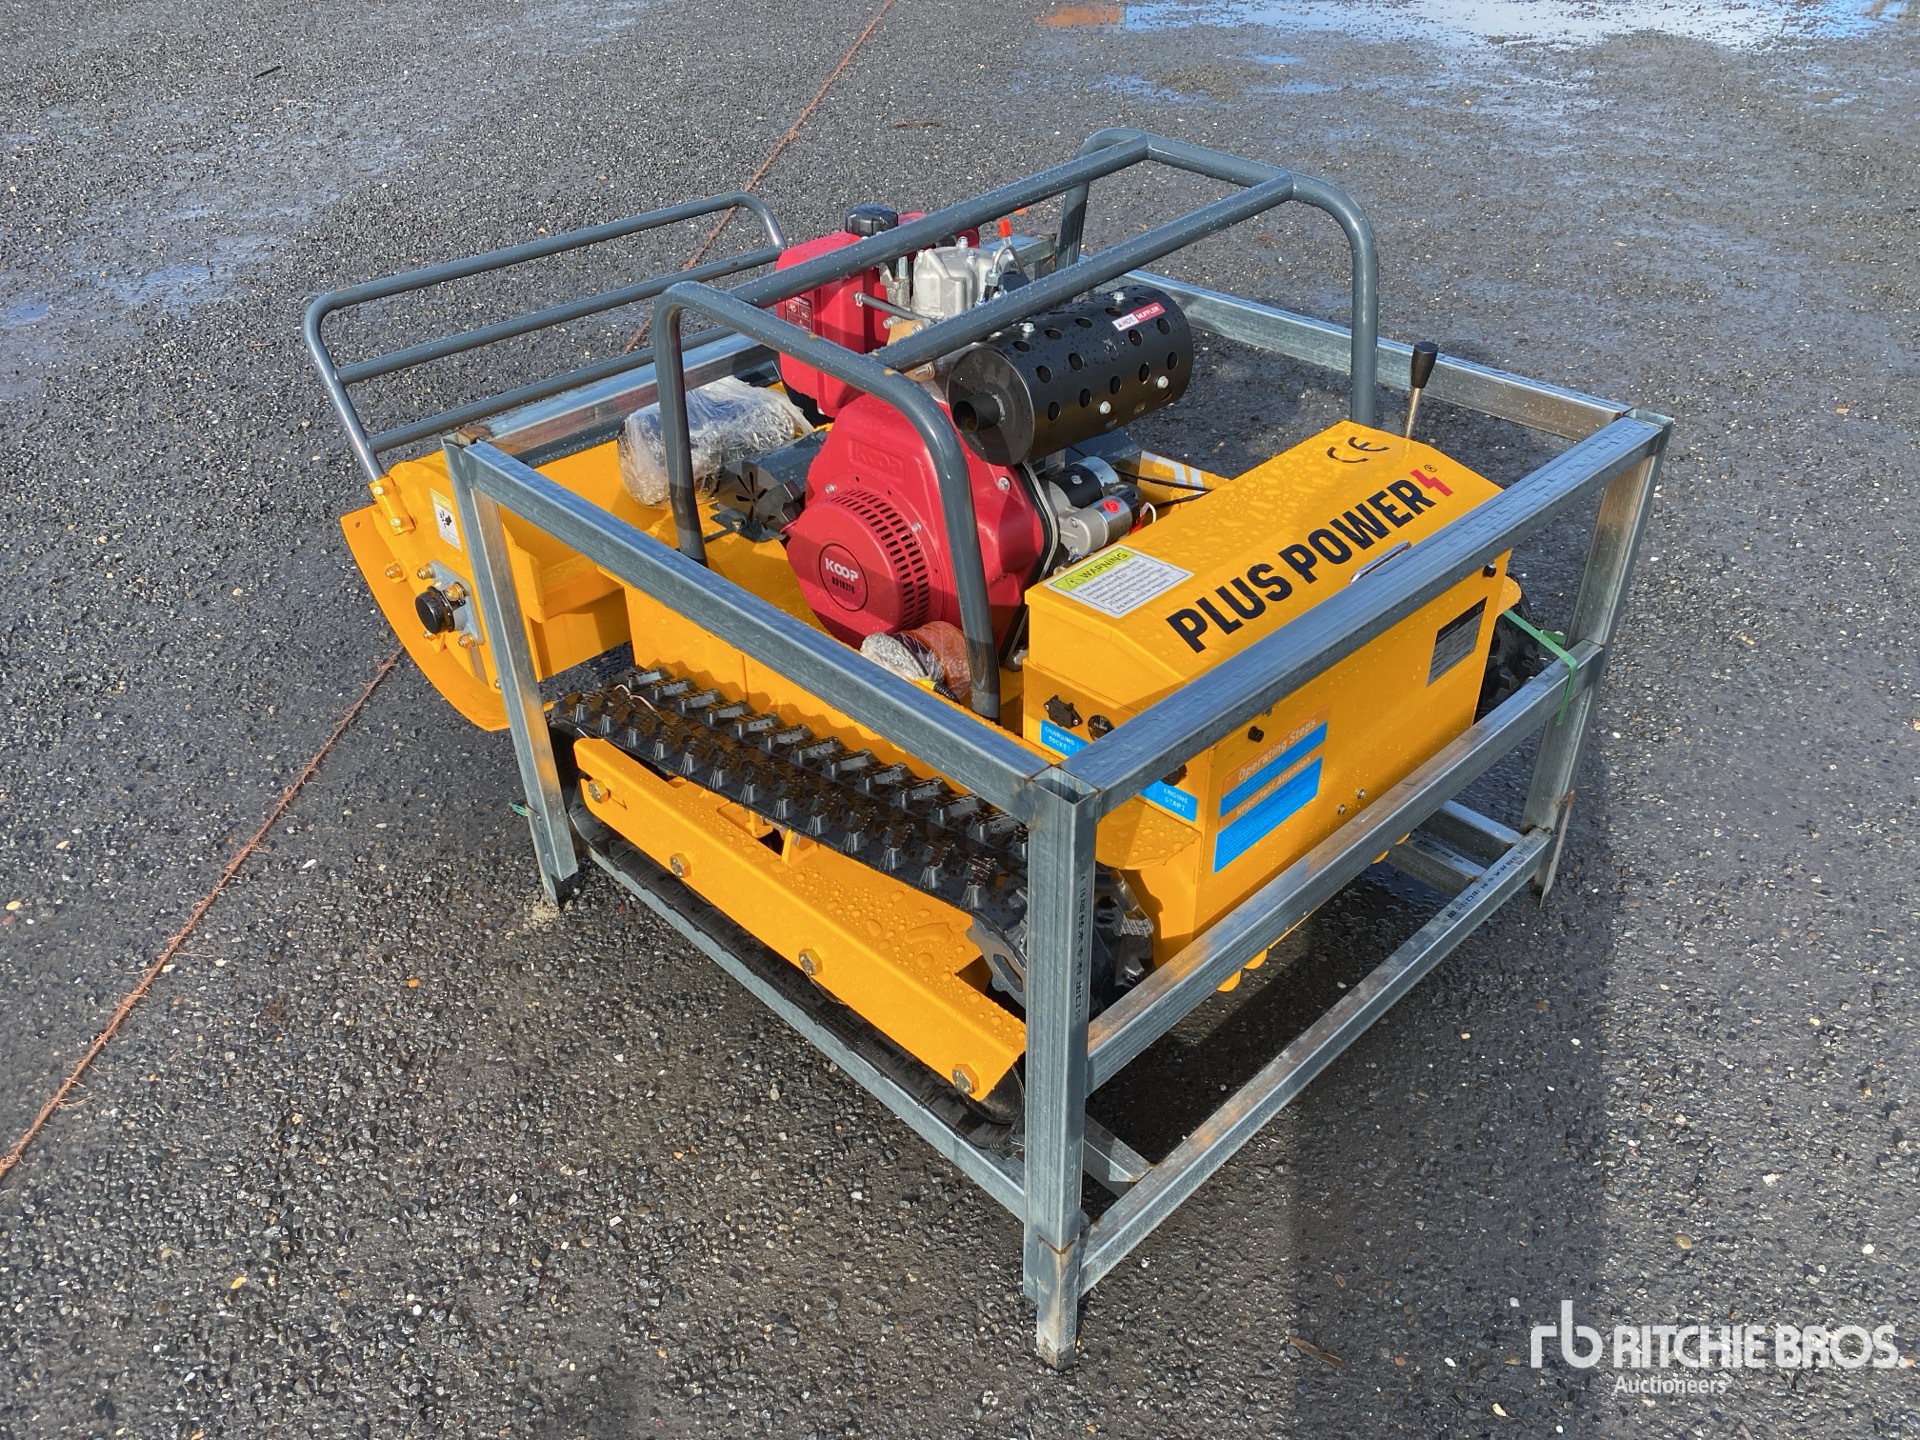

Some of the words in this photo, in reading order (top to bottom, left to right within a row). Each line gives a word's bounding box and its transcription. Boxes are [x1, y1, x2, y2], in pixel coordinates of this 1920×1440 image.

[1327, 437, 1390, 463] CE
[825, 557, 859, 582] KOOP
[1080, 552, 1128, 578] WARNING
[1166, 563, 1293, 654] PLUS
[1278, 480, 1437, 584] POWER
[1044, 726, 1075, 746] CHARGING
[1048, 735, 1071, 751] SOCKET
[1238, 740, 1287, 782] Operating
[1289, 719, 1316, 744] Steps
[1163, 788, 1188, 805] ENGINE
[1236, 782, 1275, 816] Important
[1276, 756, 1311, 787] Attention
[1164, 796, 1185, 812] START
